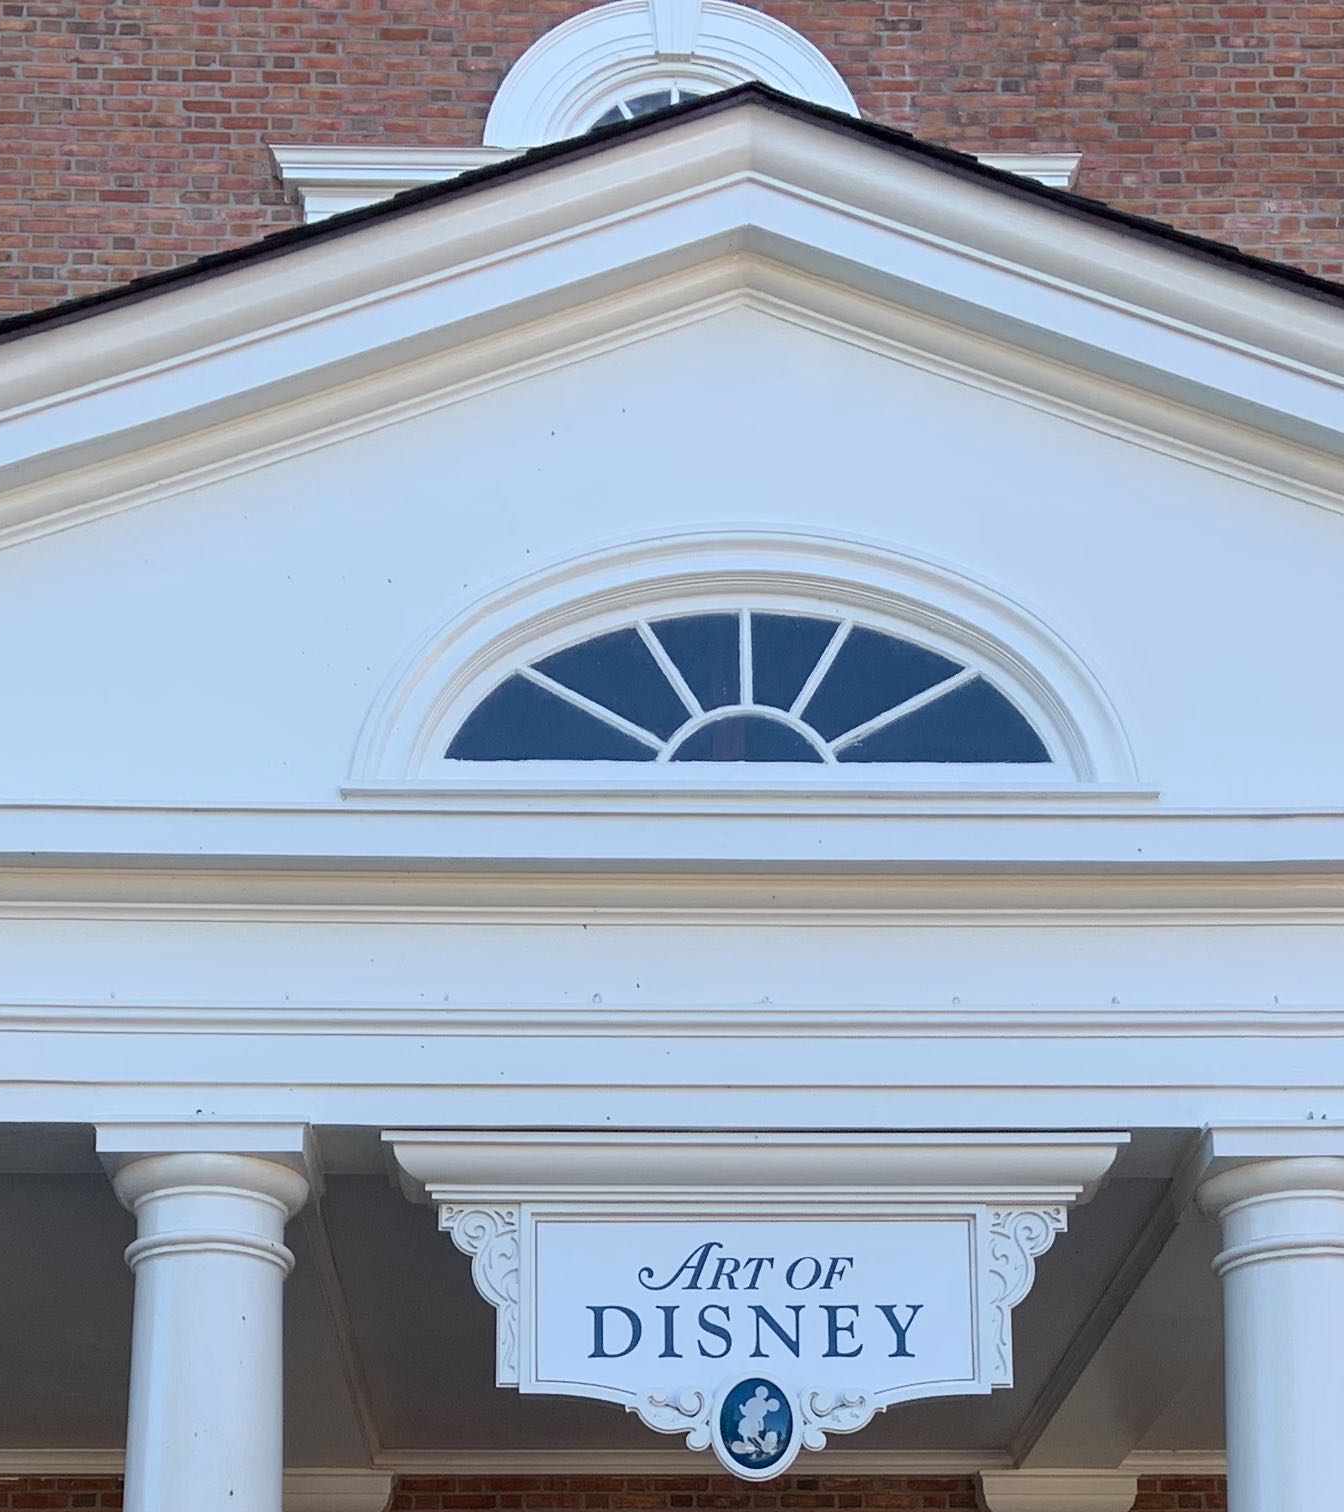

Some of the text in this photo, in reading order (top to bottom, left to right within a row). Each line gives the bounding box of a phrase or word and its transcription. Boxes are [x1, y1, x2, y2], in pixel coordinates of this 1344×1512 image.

[638, 1241, 854, 1291] ART OF
[585, 1304, 924, 1358] DISNEY
